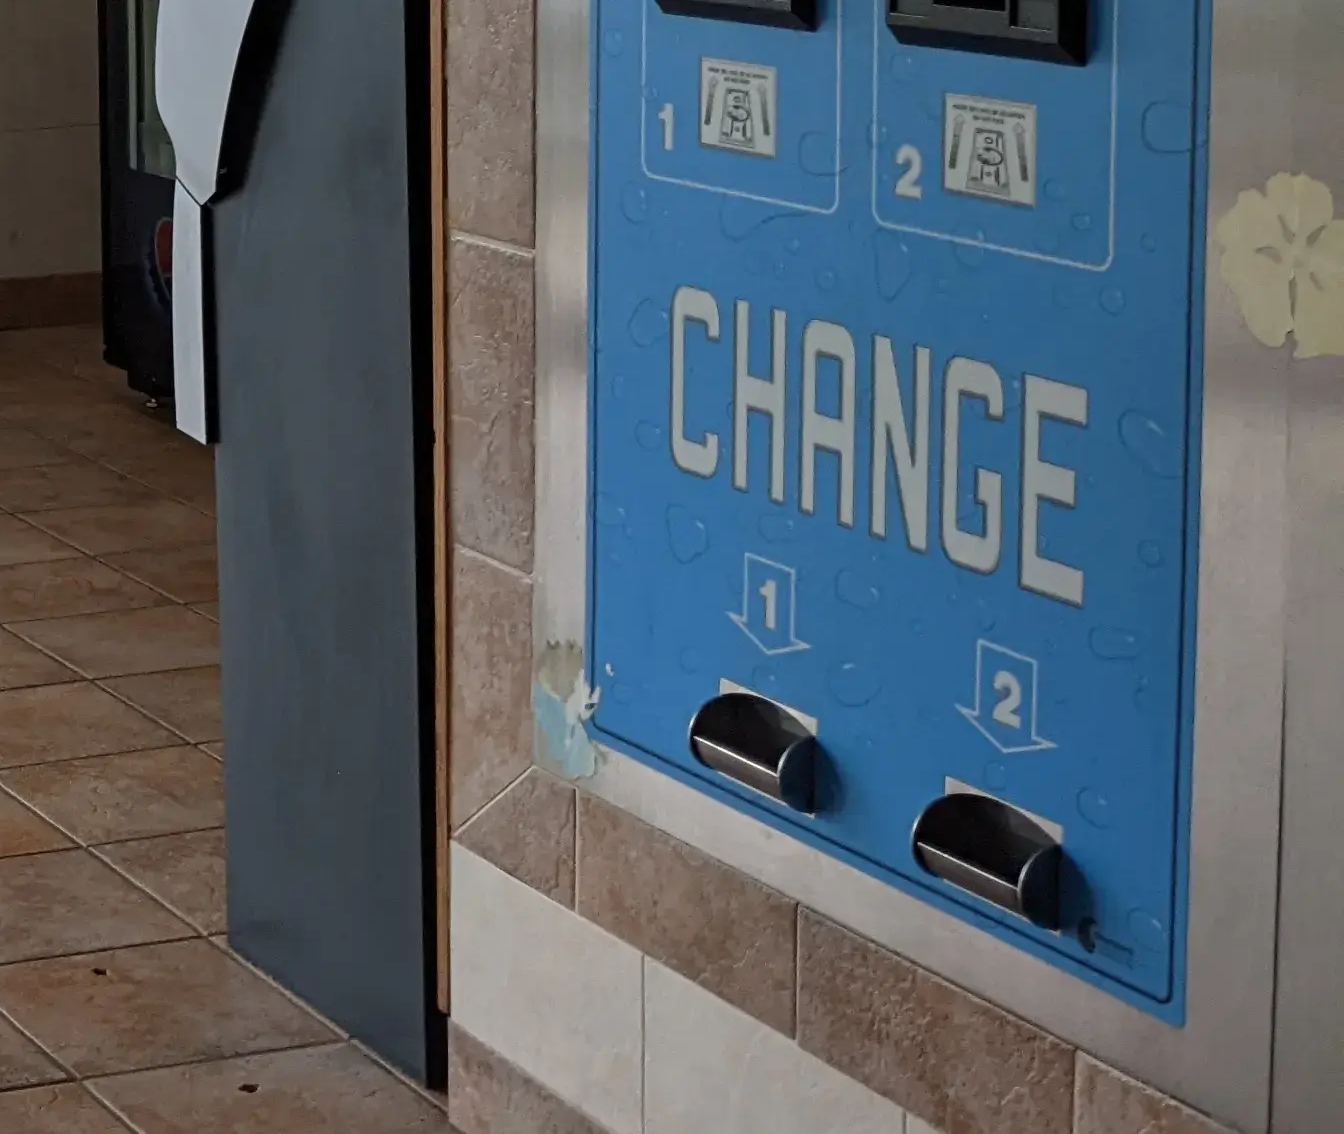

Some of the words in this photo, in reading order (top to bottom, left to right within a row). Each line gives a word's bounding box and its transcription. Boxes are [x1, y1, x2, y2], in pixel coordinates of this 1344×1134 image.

[658, 103, 675, 151] 1
[895, 144, 922, 200] 2
[669, 284, 1089, 609] CHANGE
[758, 578, 778, 630] 1
[991, 673, 1021, 727] 2
